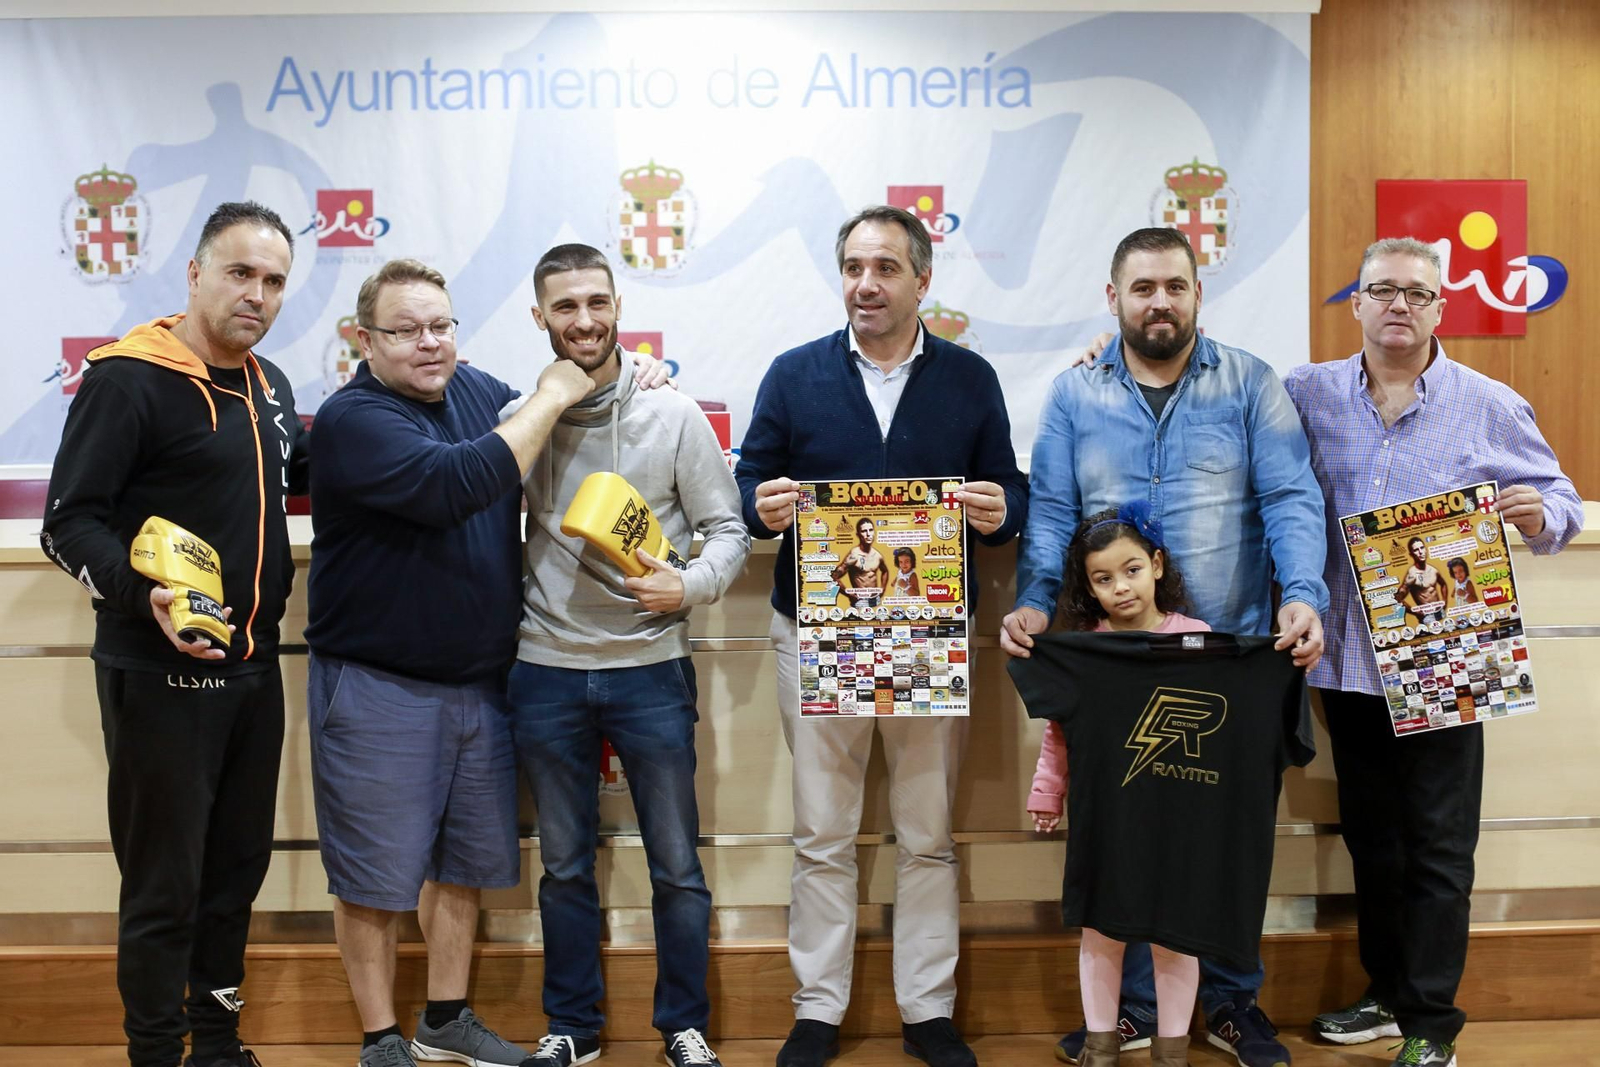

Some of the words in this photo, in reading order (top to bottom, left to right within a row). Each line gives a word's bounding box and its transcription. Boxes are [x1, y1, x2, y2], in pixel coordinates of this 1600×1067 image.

[266, 55, 679, 128] Ayuntamiento
[707, 54, 781, 110] de
[801, 52, 1032, 109] Almería
[829, 481, 928, 503] BOXEO
[1374, 492, 1465, 530] BOXEO
[1171, 720, 1199, 729] BOXING
[1152, 761, 1220, 785] RAYITO
